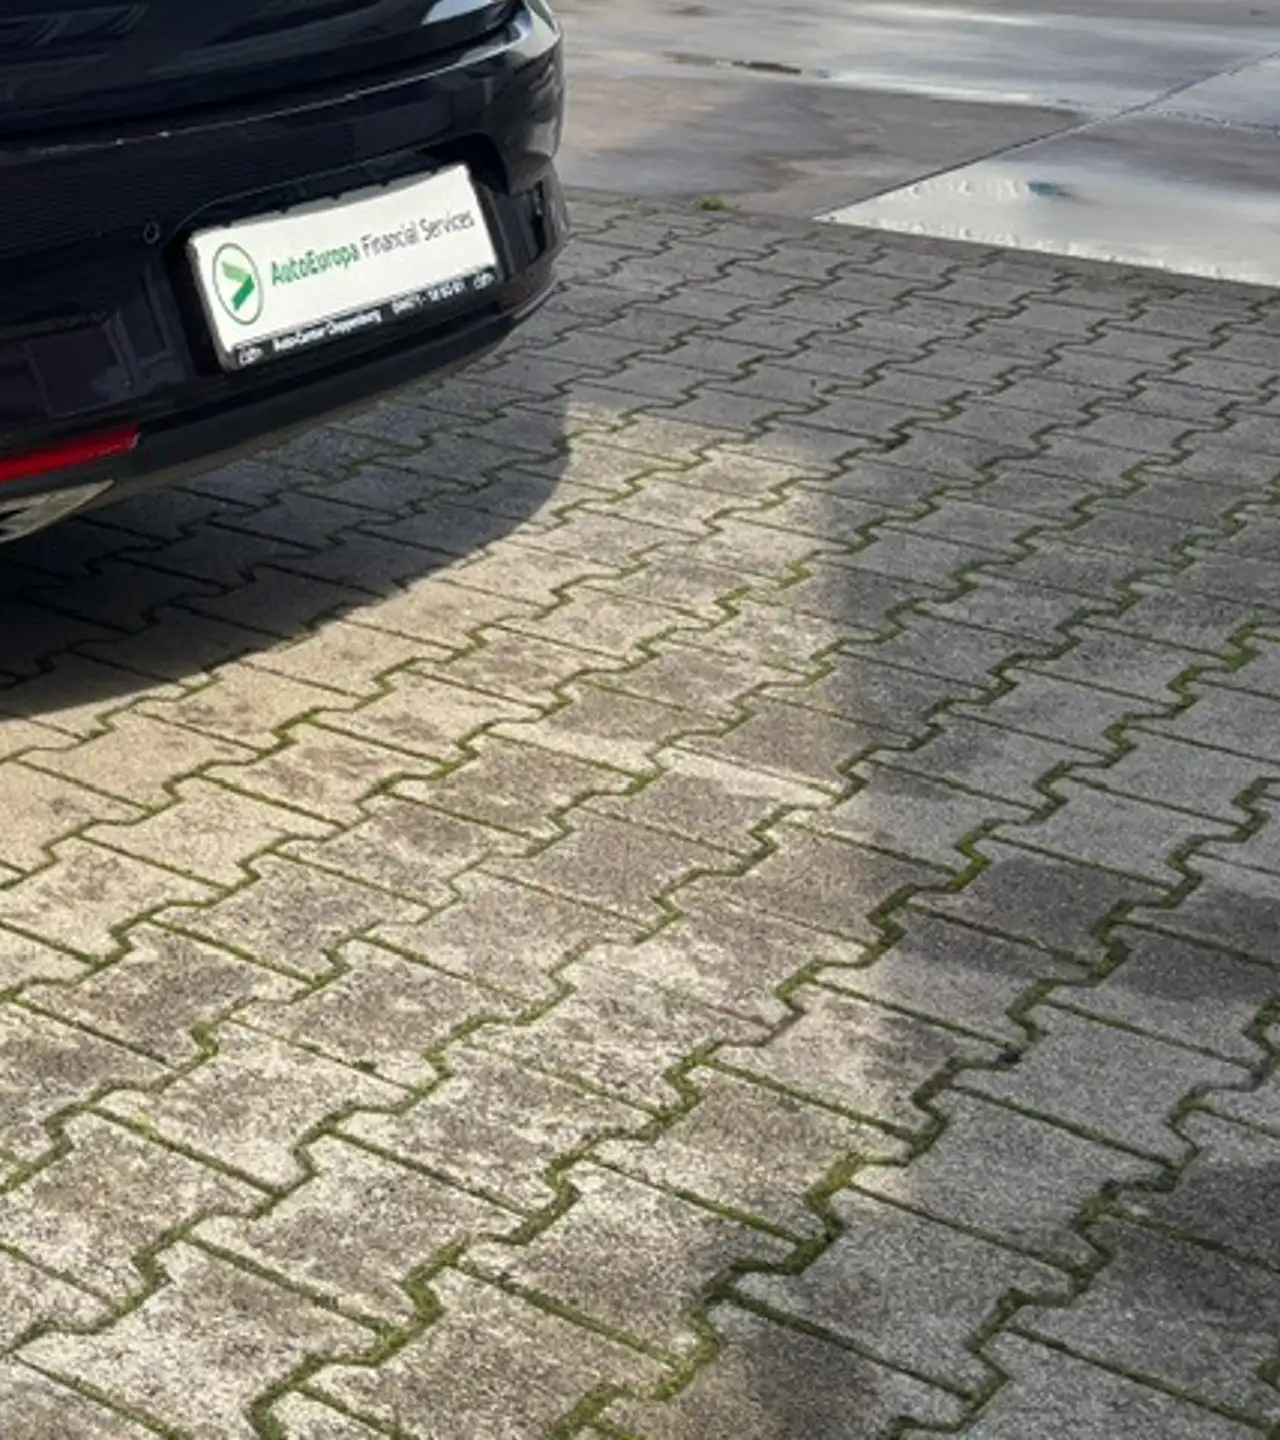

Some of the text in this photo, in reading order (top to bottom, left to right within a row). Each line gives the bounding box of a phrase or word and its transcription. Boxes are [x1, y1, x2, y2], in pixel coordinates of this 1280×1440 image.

[271, 210, 475, 286] AutoEuropa Financial Services
